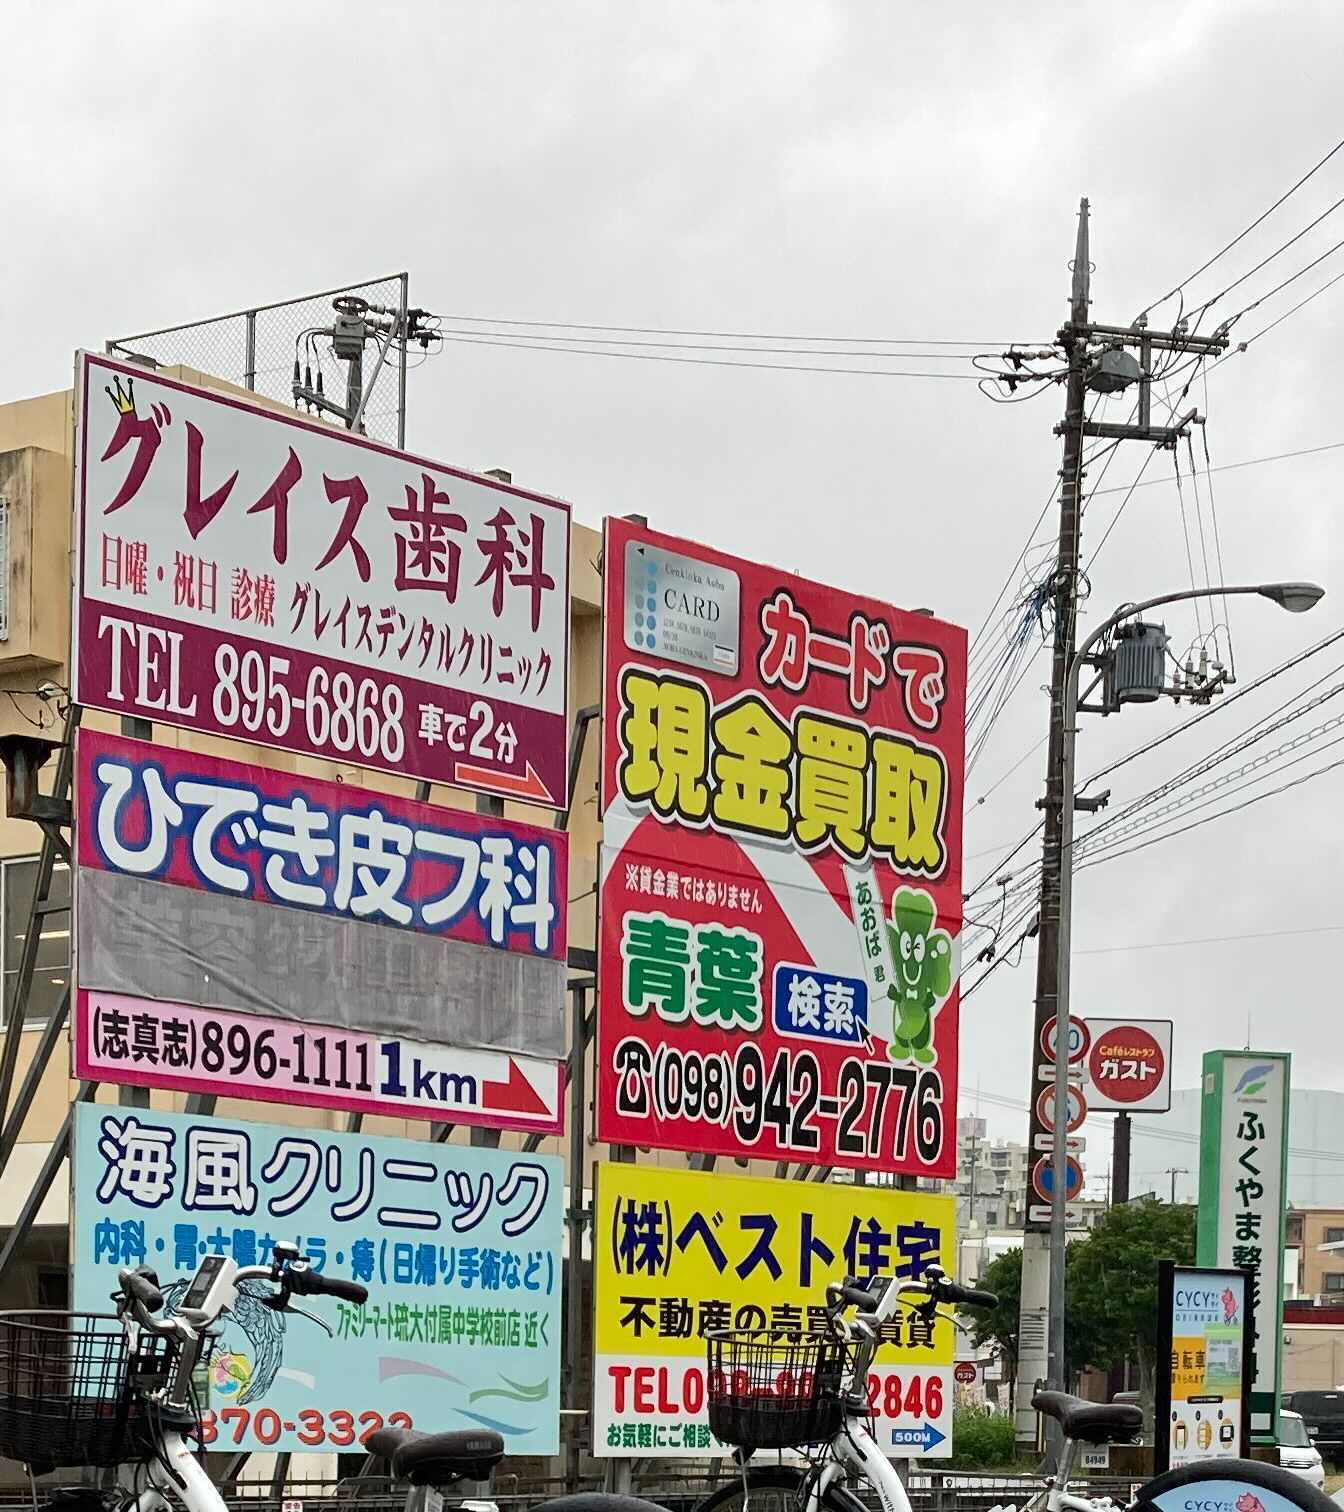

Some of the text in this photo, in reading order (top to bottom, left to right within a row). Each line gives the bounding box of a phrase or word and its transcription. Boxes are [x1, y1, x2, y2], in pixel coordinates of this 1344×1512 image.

[100, 401, 555, 632] グレイス歯科
[100, 532, 552, 696] 日曜・祝日 診療 グレイスデンタルクリニック
[664, 588, 720, 622] CARD
[98, 615, 519, 764] TEL 895-6868 車で2分
[760, 592, 945, 729] カードで
[619, 664, 948, 876] 現金買取
[97, 762, 555, 950] ひでき皮フ科
[622, 912, 763, 1030] 青葉
[787, 974, 855, 1035] 検索
[381, 1040, 477, 1105] 1km
[655, 1040, 943, 1164] (098)942-2776
[1099, 1060, 1156, 1081] ガスト
[97, 1116, 549, 1236] 海風クリニック
[94, 1217, 554, 1295] 内科・胃・大腸カラ・痔(日帰り手術など)
[524, 1311, 549, 1348] 近く
[619, 1296, 936, 1349] 不動産の売買賃貸
[895, 1431, 931, 1443] 500M
[1184, 1499, 1223, 1512] CYCY
